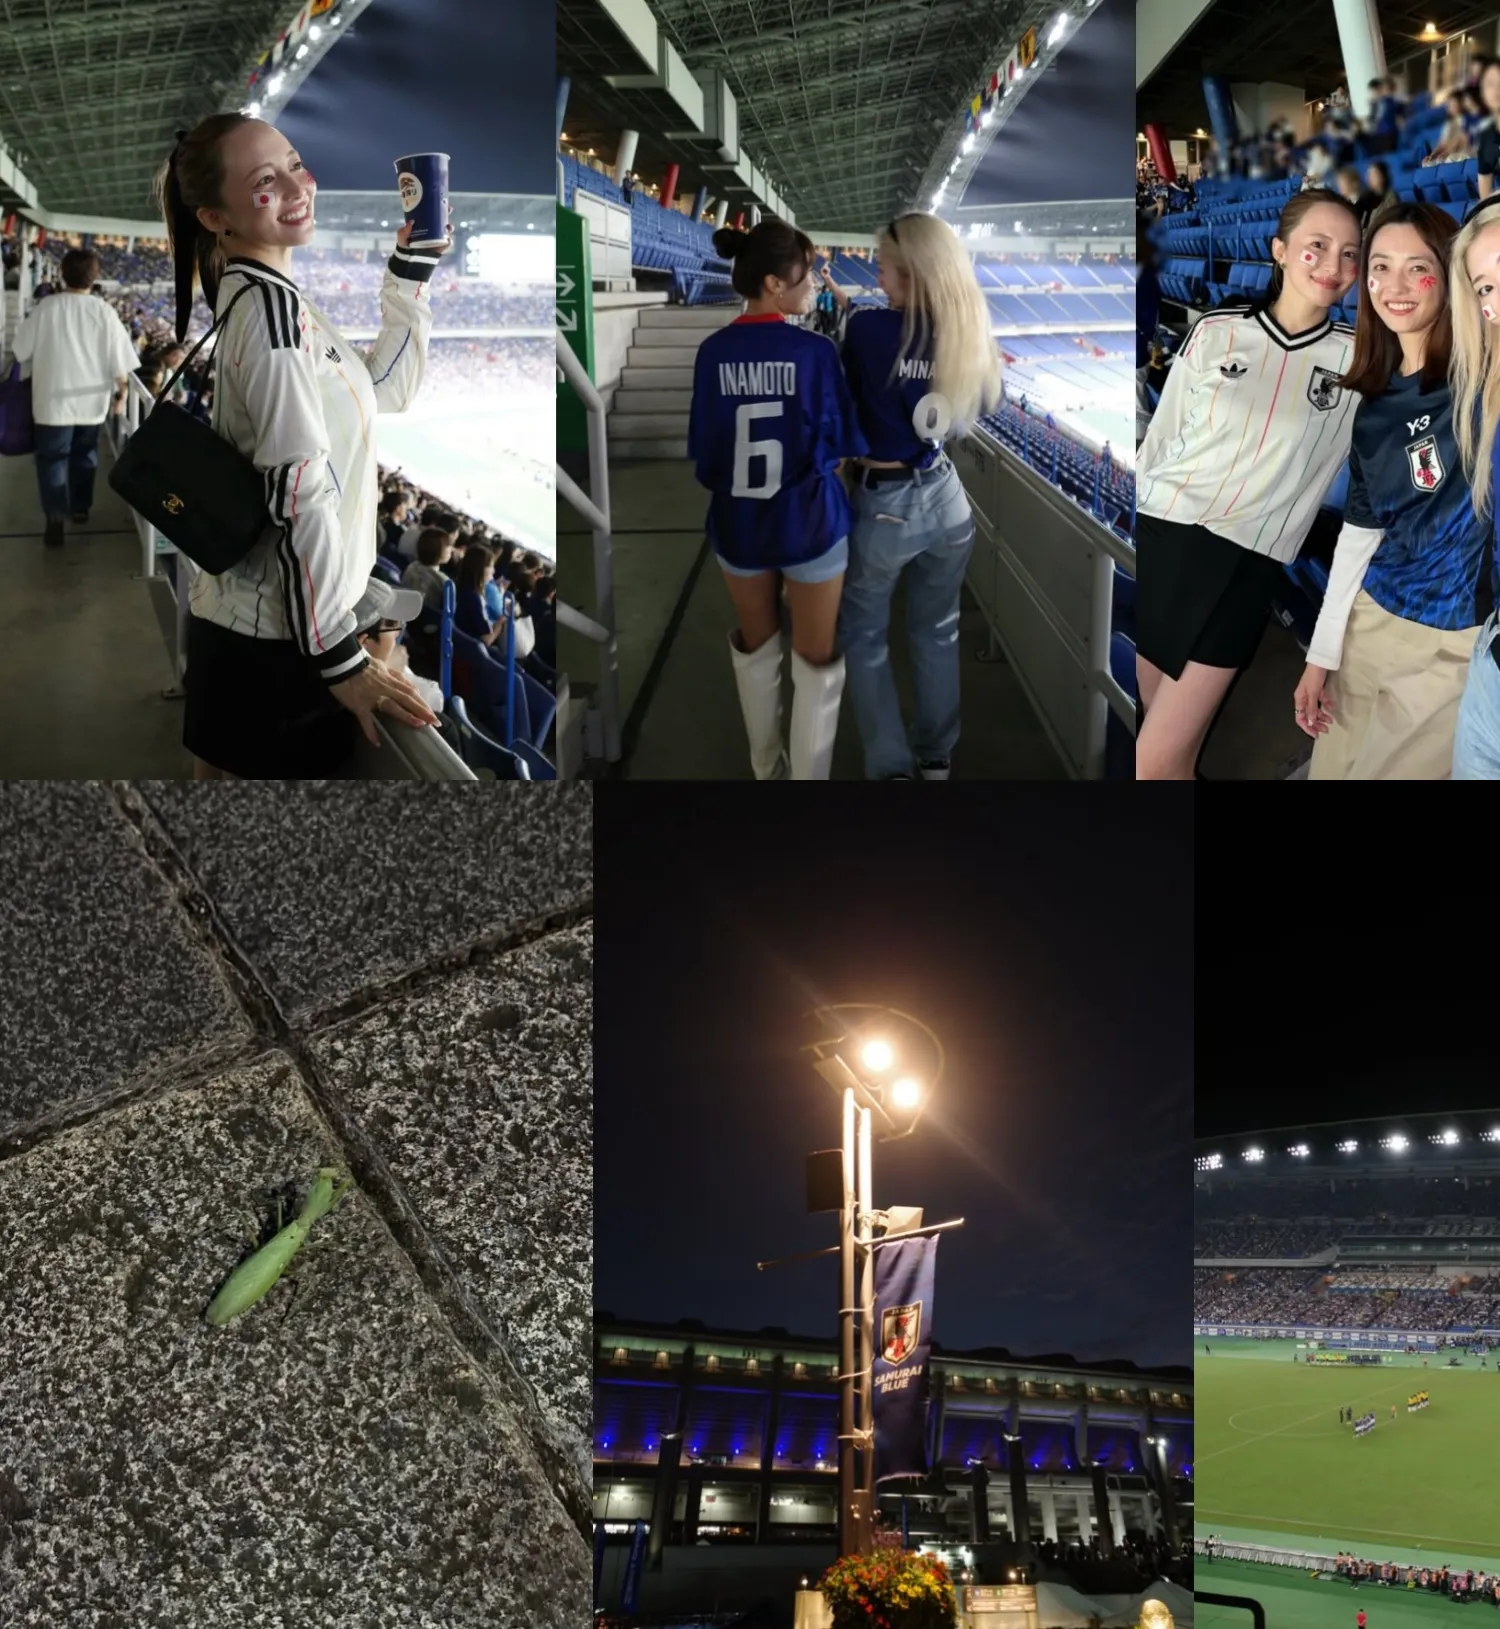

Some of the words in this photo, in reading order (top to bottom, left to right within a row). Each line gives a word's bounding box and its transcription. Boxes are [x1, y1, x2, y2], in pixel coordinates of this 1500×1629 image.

[719, 362, 796, 396] INAMOTO
[899, 358, 938, 380] MINA
[1406, 414, 1431, 437] Y-3
[731, 401, 784, 500] 6
[1413, 440, 1429, 451] JAPAN
[874, 1364, 923, 1387] SAMURAI
[881, 1378, 909, 1394] BLUE
